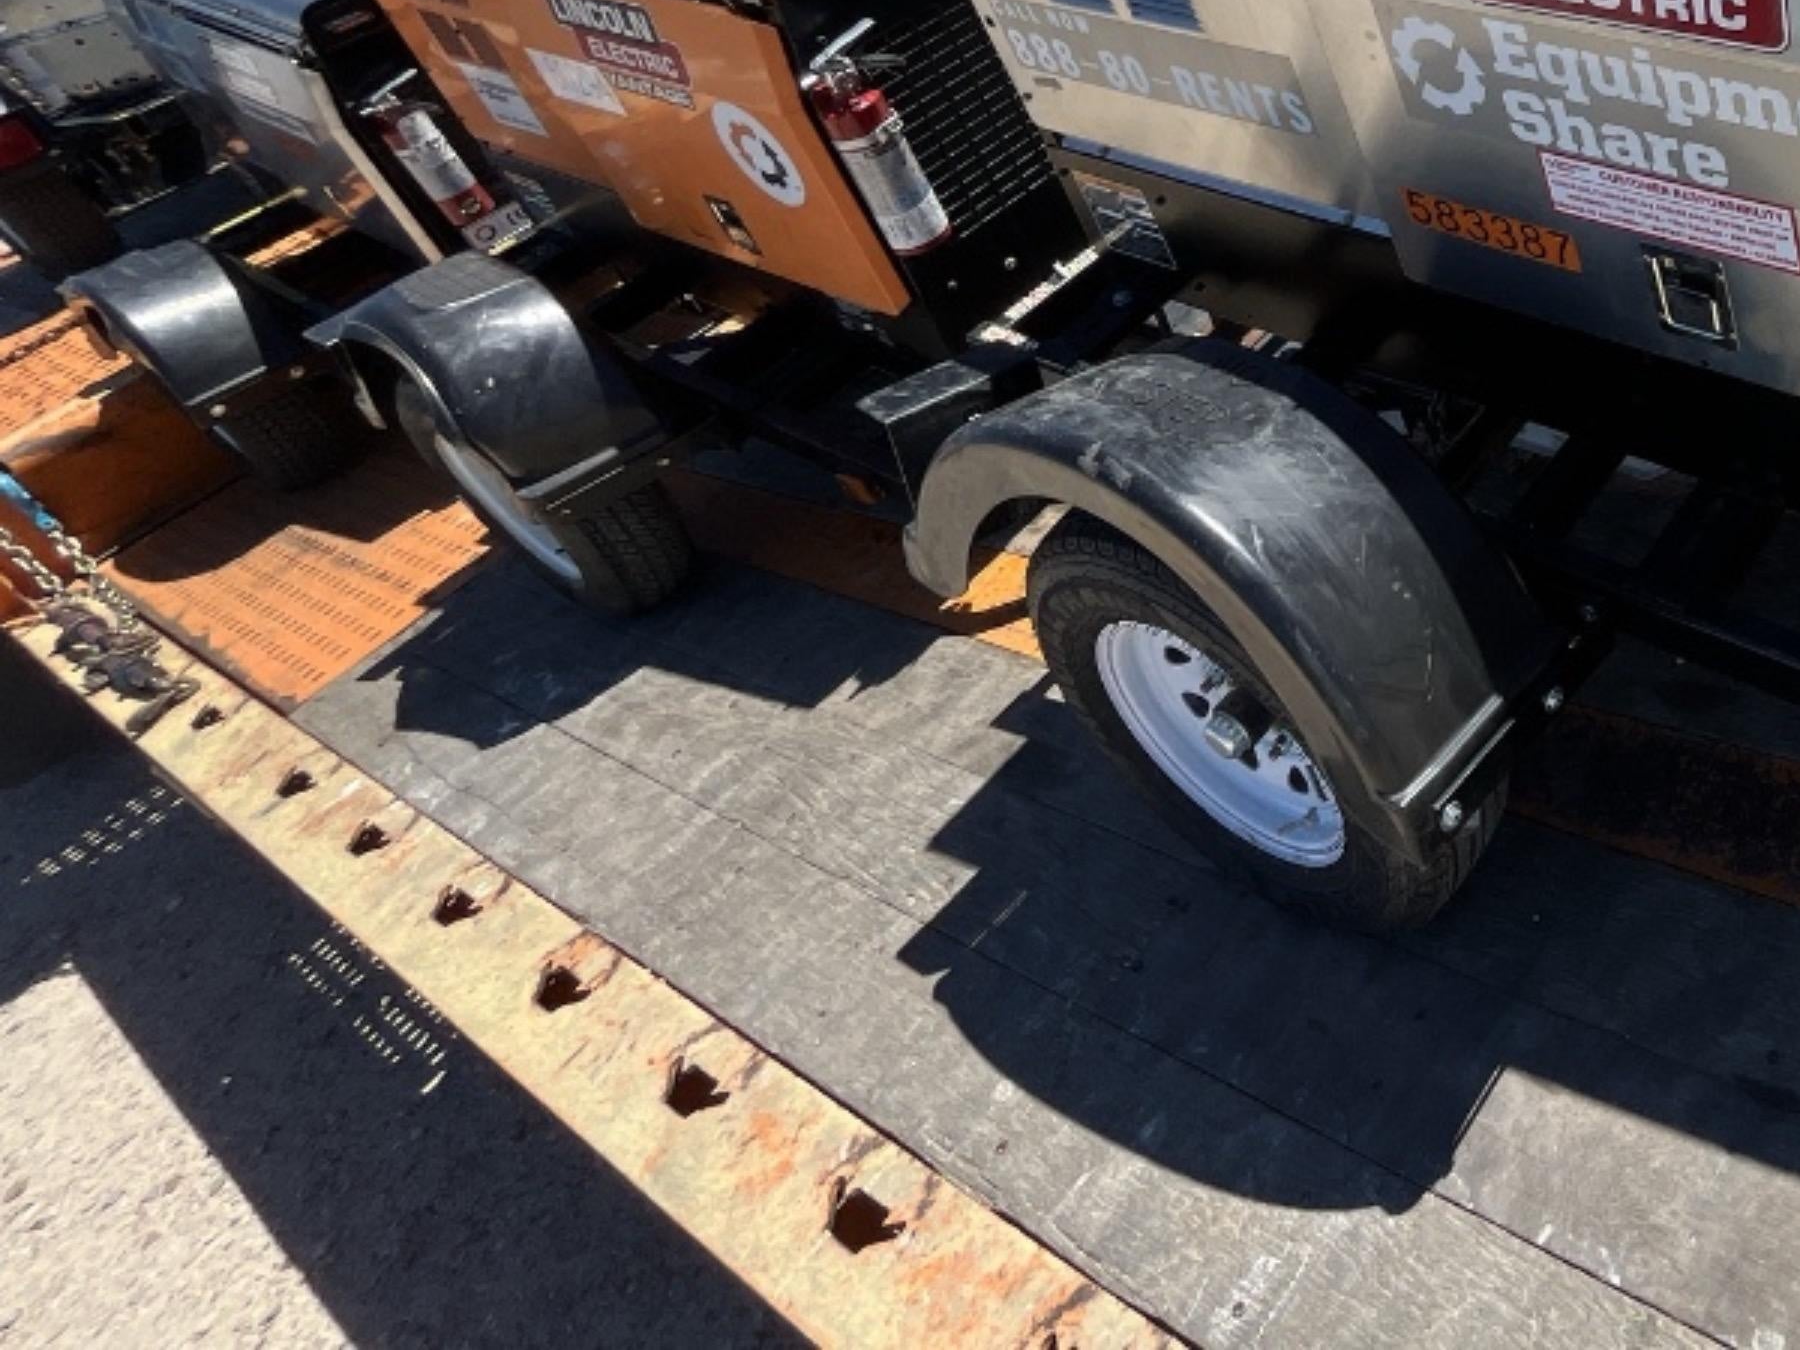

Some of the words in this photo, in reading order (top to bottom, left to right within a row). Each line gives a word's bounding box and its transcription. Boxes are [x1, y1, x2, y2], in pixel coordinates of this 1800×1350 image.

[585, 35, 679, 80] ELECTRIC
[1500, 88, 1730, 188] Share
[1406, 188, 1570, 265] 583387
